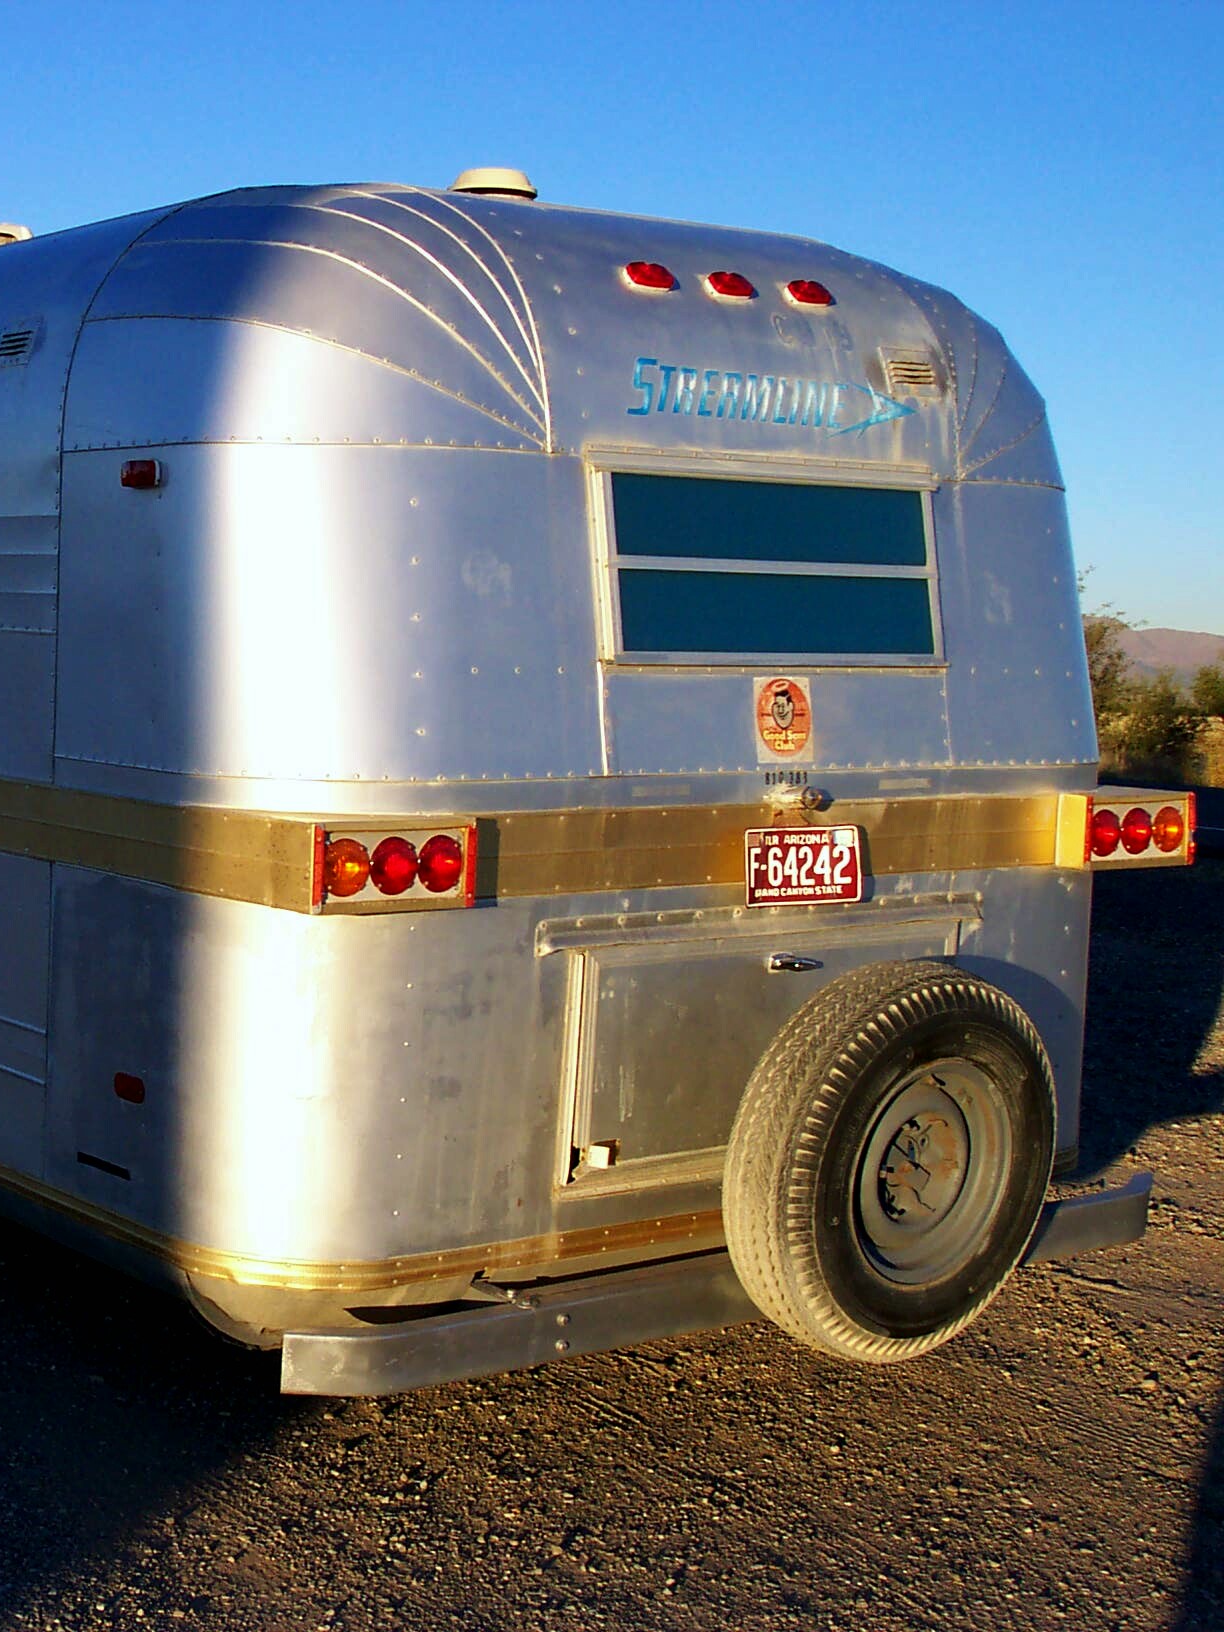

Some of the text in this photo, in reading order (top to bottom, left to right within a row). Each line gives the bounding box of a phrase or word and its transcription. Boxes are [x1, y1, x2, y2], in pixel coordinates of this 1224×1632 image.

[628, 357, 848, 428] STREAMLINE
[763, 730, 806, 740] Good Sam
[775, 741, 795, 750] Club
[784, 833, 830, 844] ARIZONA
[750, 846, 852, 888] F-64242
[781, 887, 814, 897] CANYON
[815, 885, 843, 895] STATE
